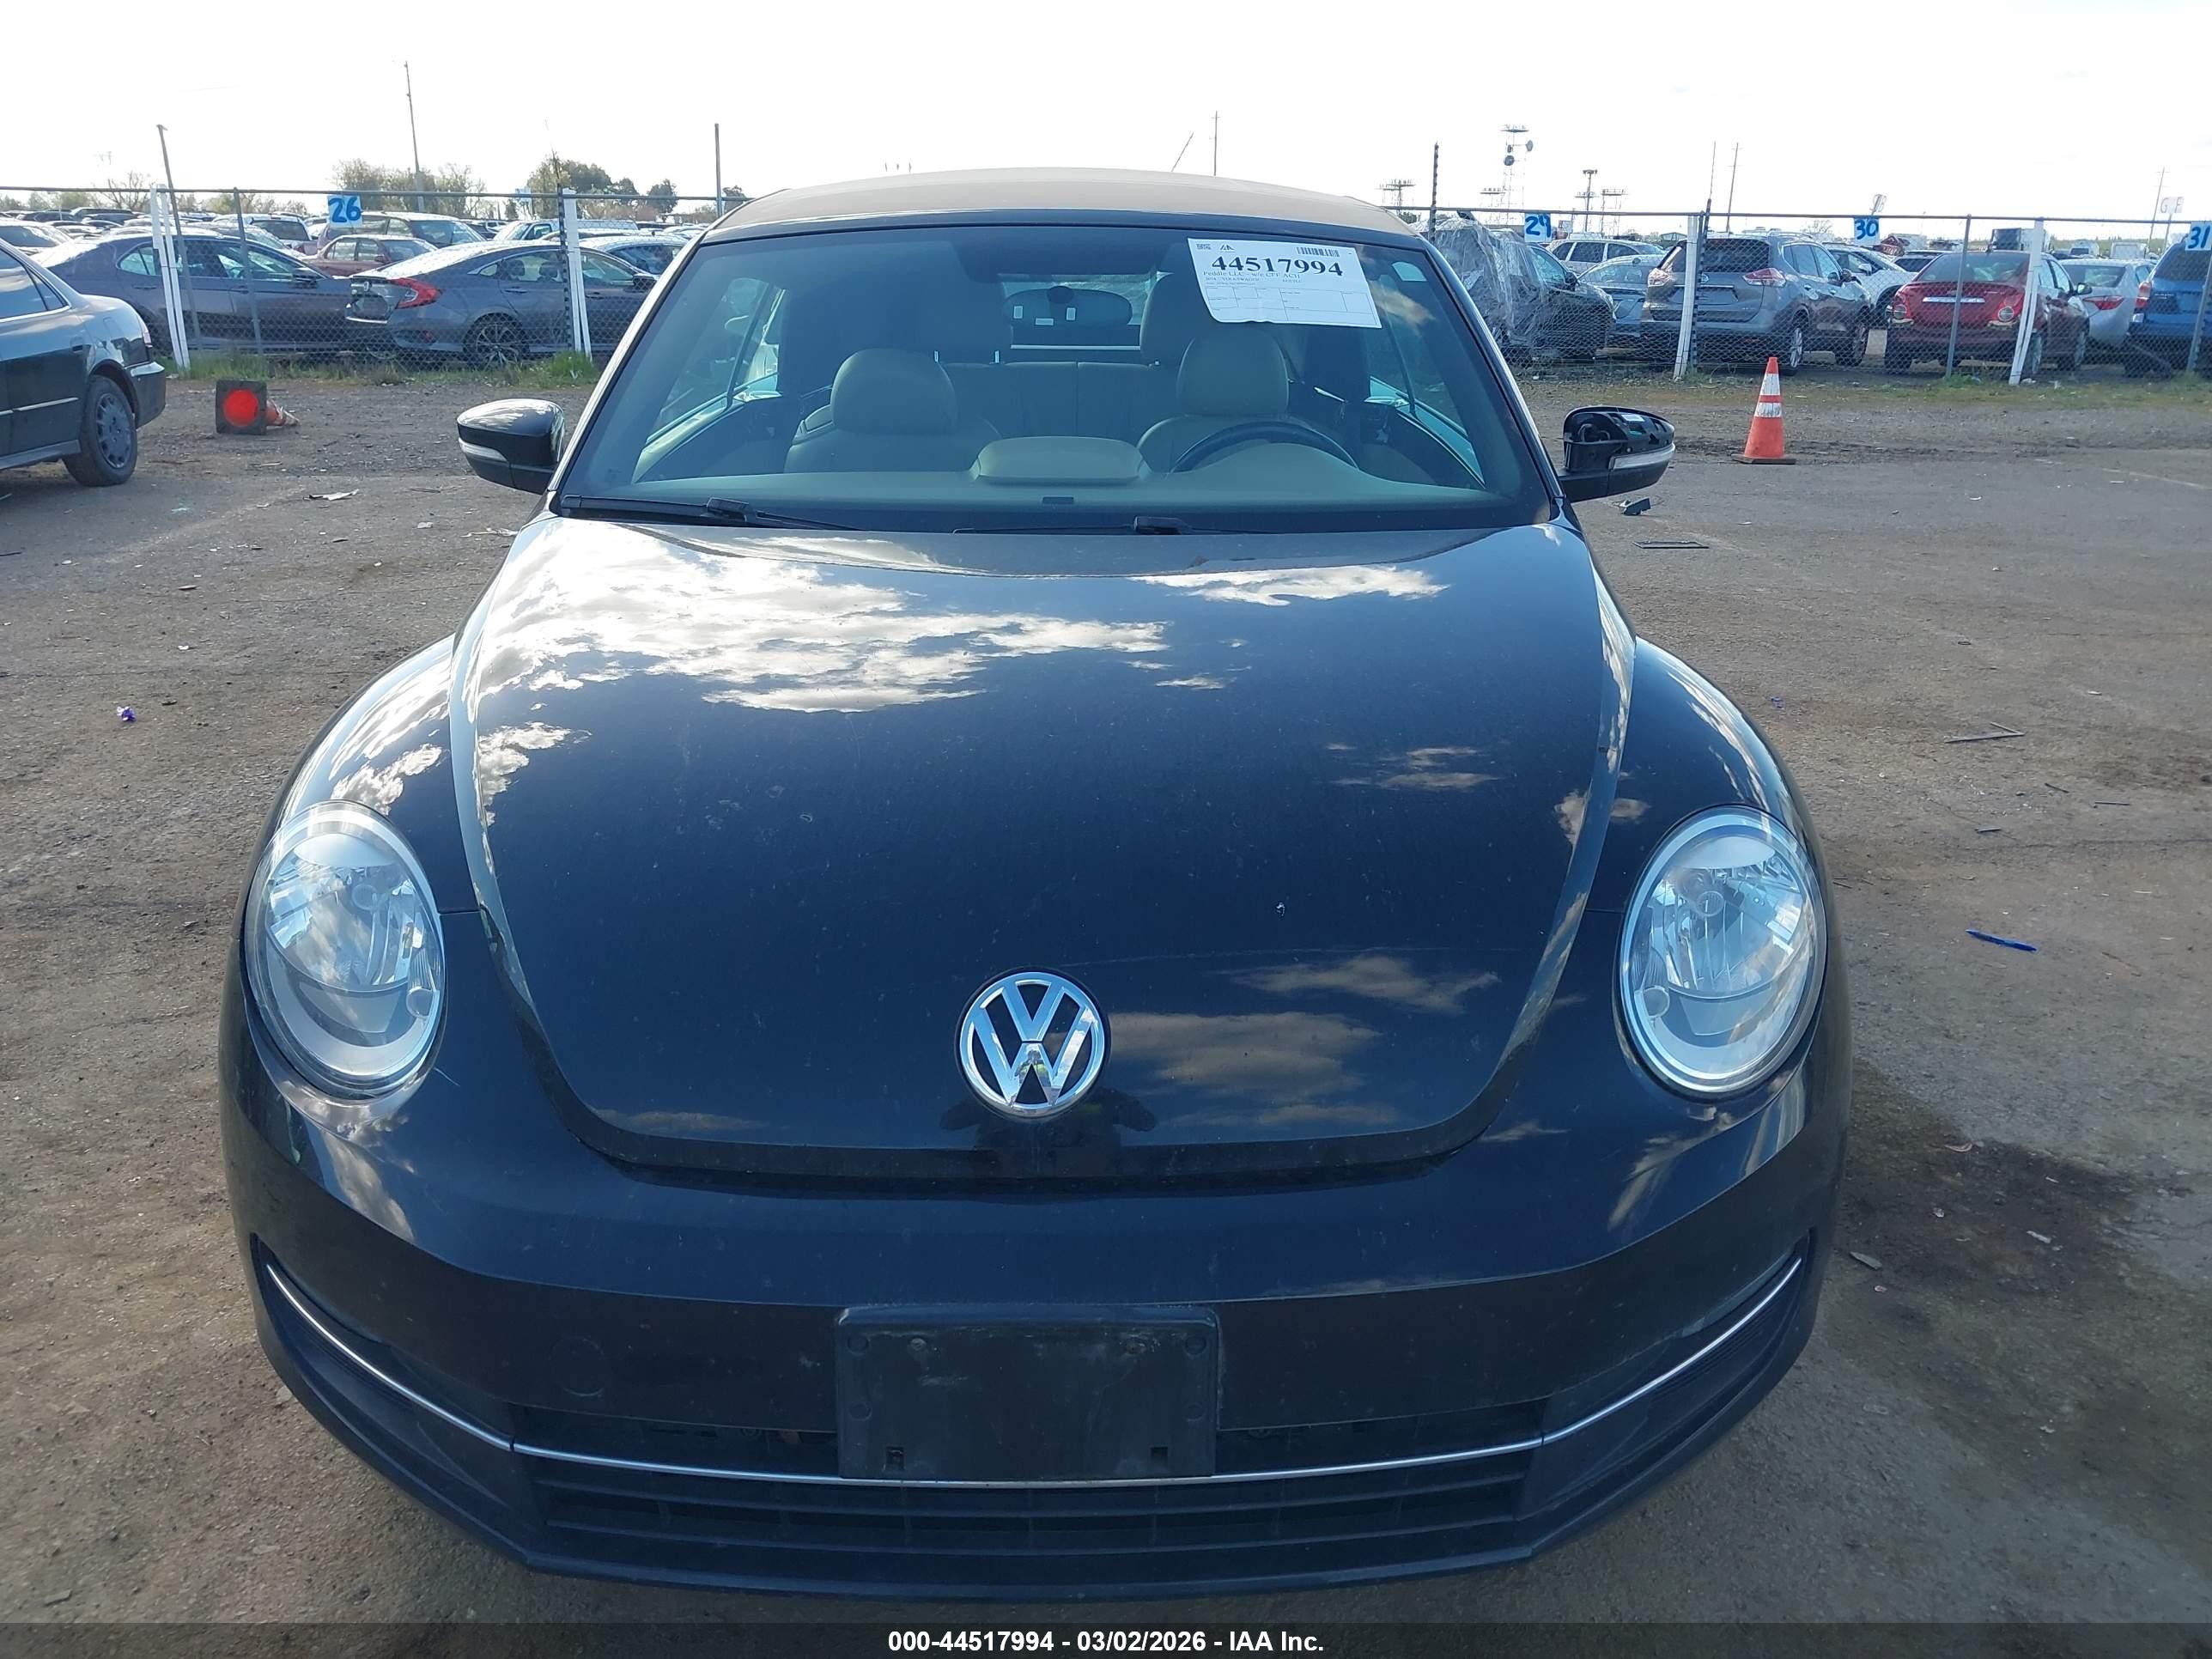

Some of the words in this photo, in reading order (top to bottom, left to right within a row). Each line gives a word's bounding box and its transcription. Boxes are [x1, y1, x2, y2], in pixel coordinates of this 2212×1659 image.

[328, 197, 362, 222] 26
[1855, 219, 1879, 240] 30
[2188, 225, 2210, 249] 31
[1212, 256, 1343, 276] 44517994
